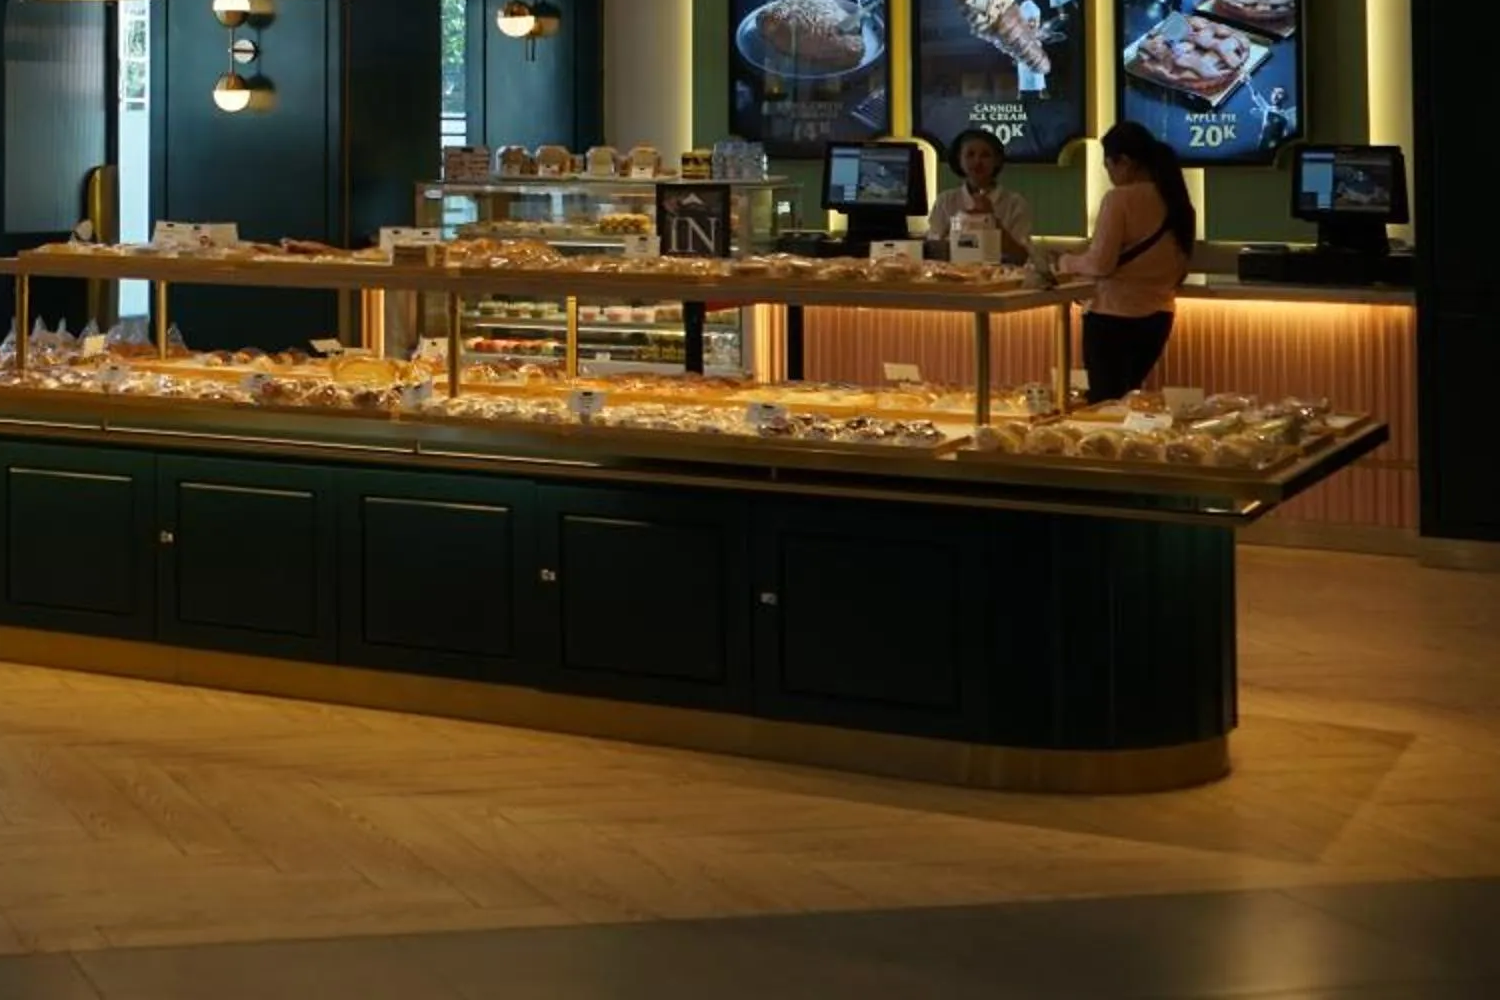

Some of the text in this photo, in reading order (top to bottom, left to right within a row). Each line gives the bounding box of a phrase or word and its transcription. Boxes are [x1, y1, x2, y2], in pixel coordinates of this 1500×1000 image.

[973, 103, 1024, 113] CANNOLI
[989, 112, 1028, 121] CREAM
[1185, 112, 1218, 122] APPLE
[1189, 124, 1237, 147] 20K
